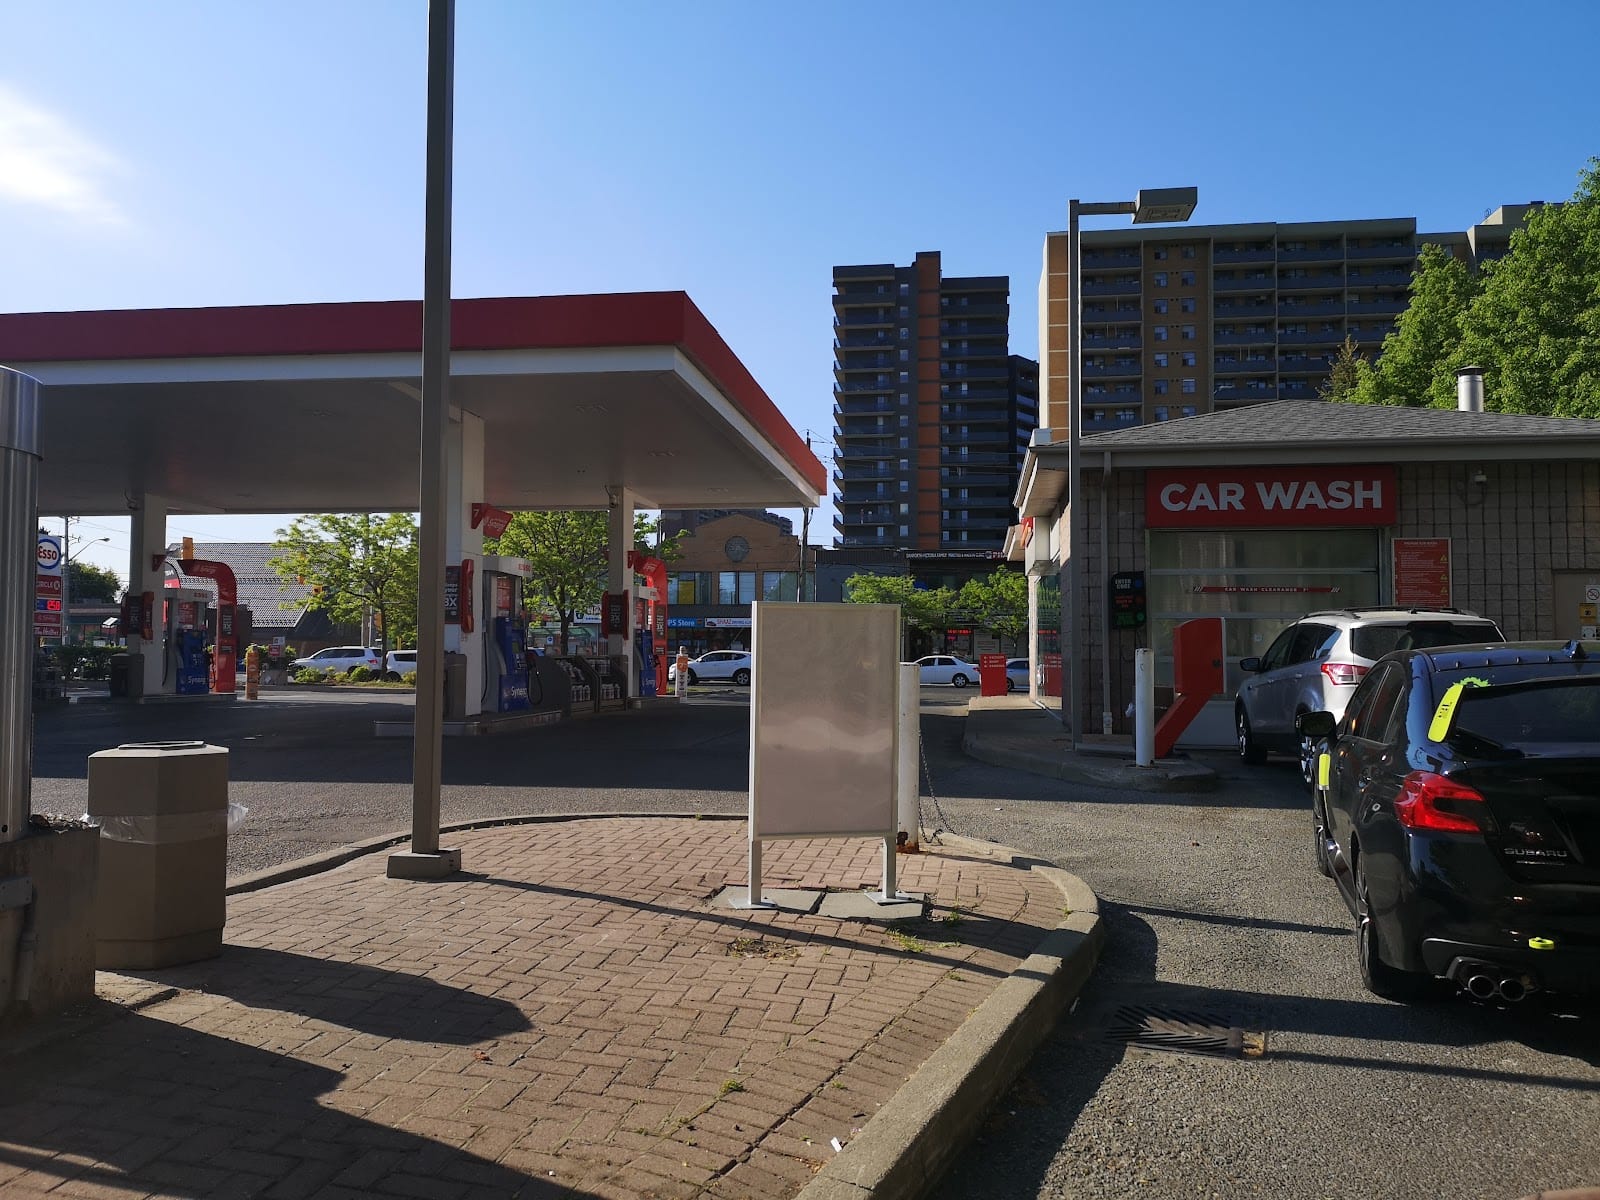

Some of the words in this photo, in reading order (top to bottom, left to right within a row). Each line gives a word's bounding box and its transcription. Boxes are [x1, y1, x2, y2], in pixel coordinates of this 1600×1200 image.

[1160, 482, 1245, 512] CAR
[1255, 480, 1383, 510] WASH
[473, 508, 480, 517] 7
[678, 619, 695, 627] Store
[1504, 848, 1568, 858] SUBARU
